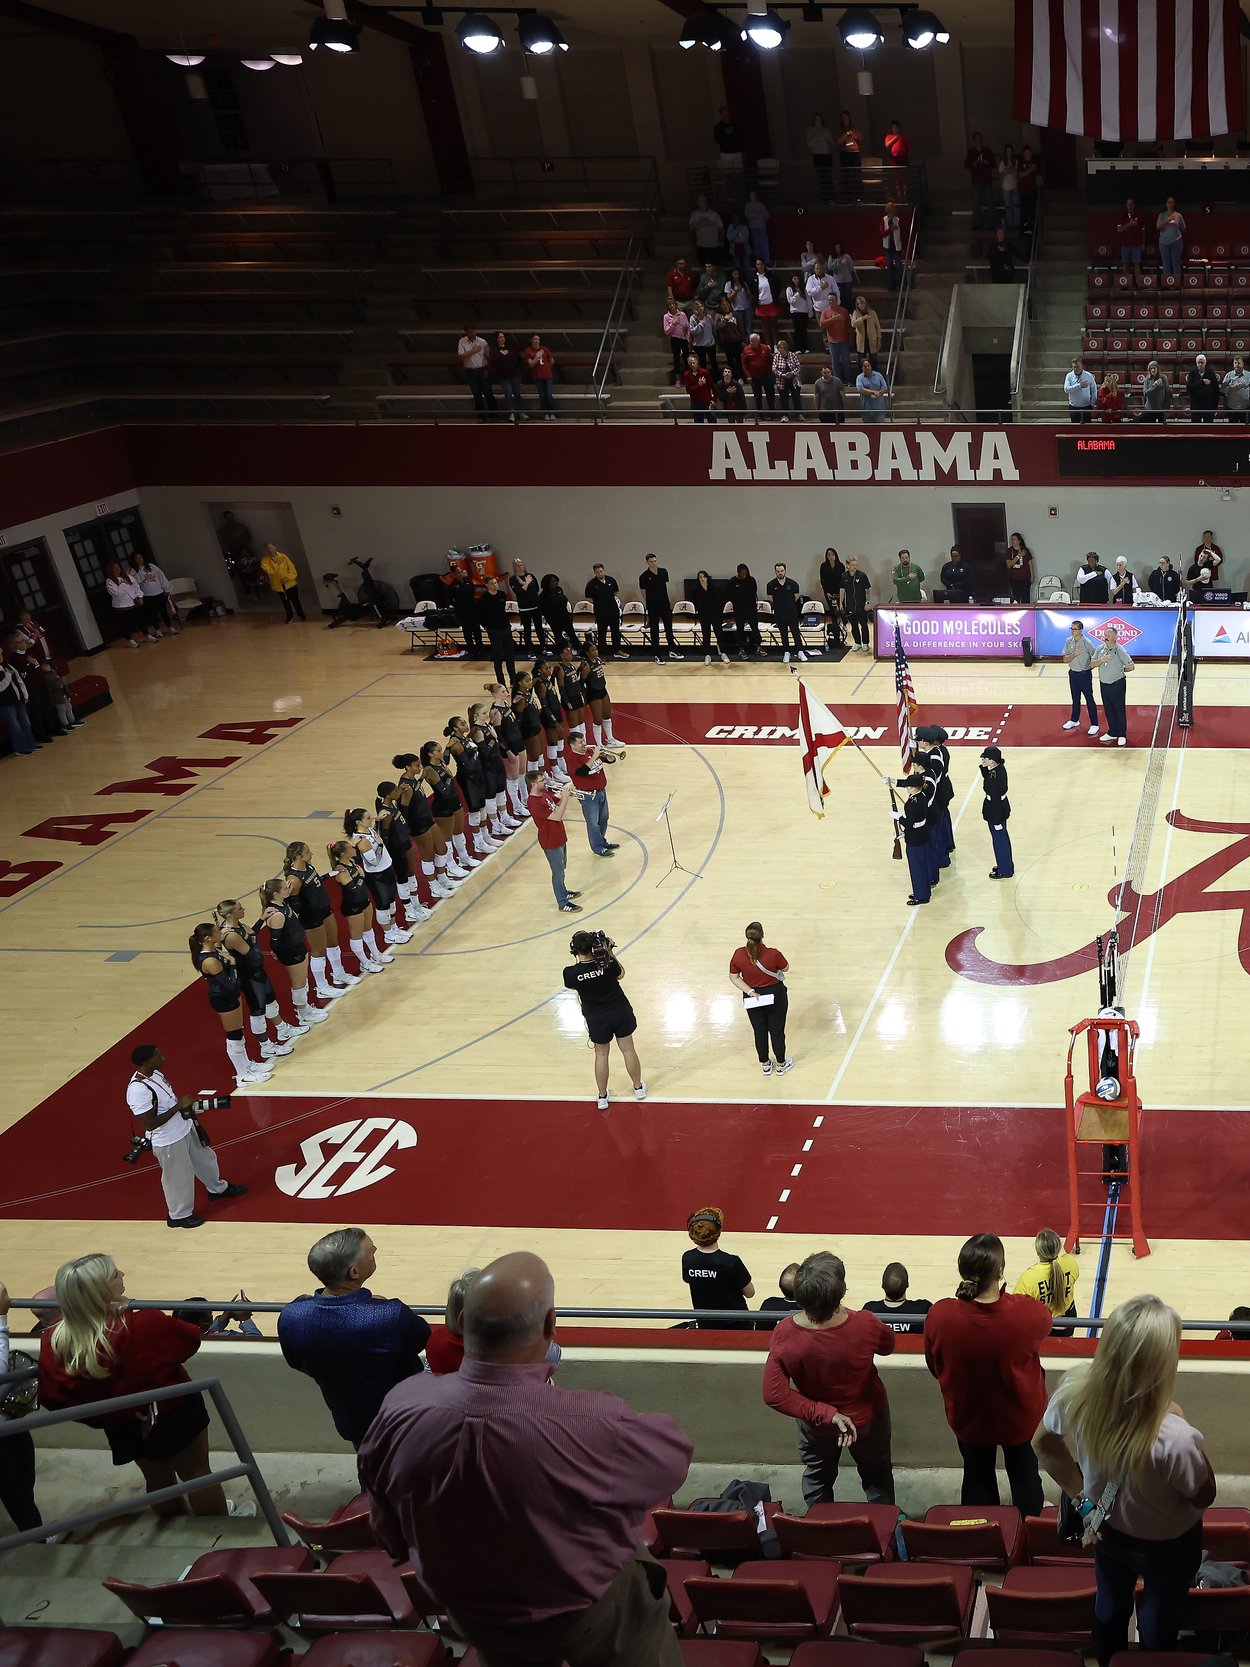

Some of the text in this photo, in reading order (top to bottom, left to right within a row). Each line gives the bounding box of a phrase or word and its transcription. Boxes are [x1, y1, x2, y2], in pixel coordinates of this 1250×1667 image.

[1077, 440, 1116, 451] ALABAMA
[708, 431, 1021, 481] ALABAMA
[903, 620, 940, 635] GOOD
[1094, 629, 1138, 637] DIOND
[705, 726, 889, 740] CRIMN
[313, 876, 322, 888] 5
[577, 967, 605, 982] CREW
[274, 1117, 419, 1200] SEC
[688, 1268, 718, 1279] CREW
[1038, 1272, 1071, 1295] EVT
[885, 1323, 911, 1332] REW
[24, 1599, 51, 1620] 2
